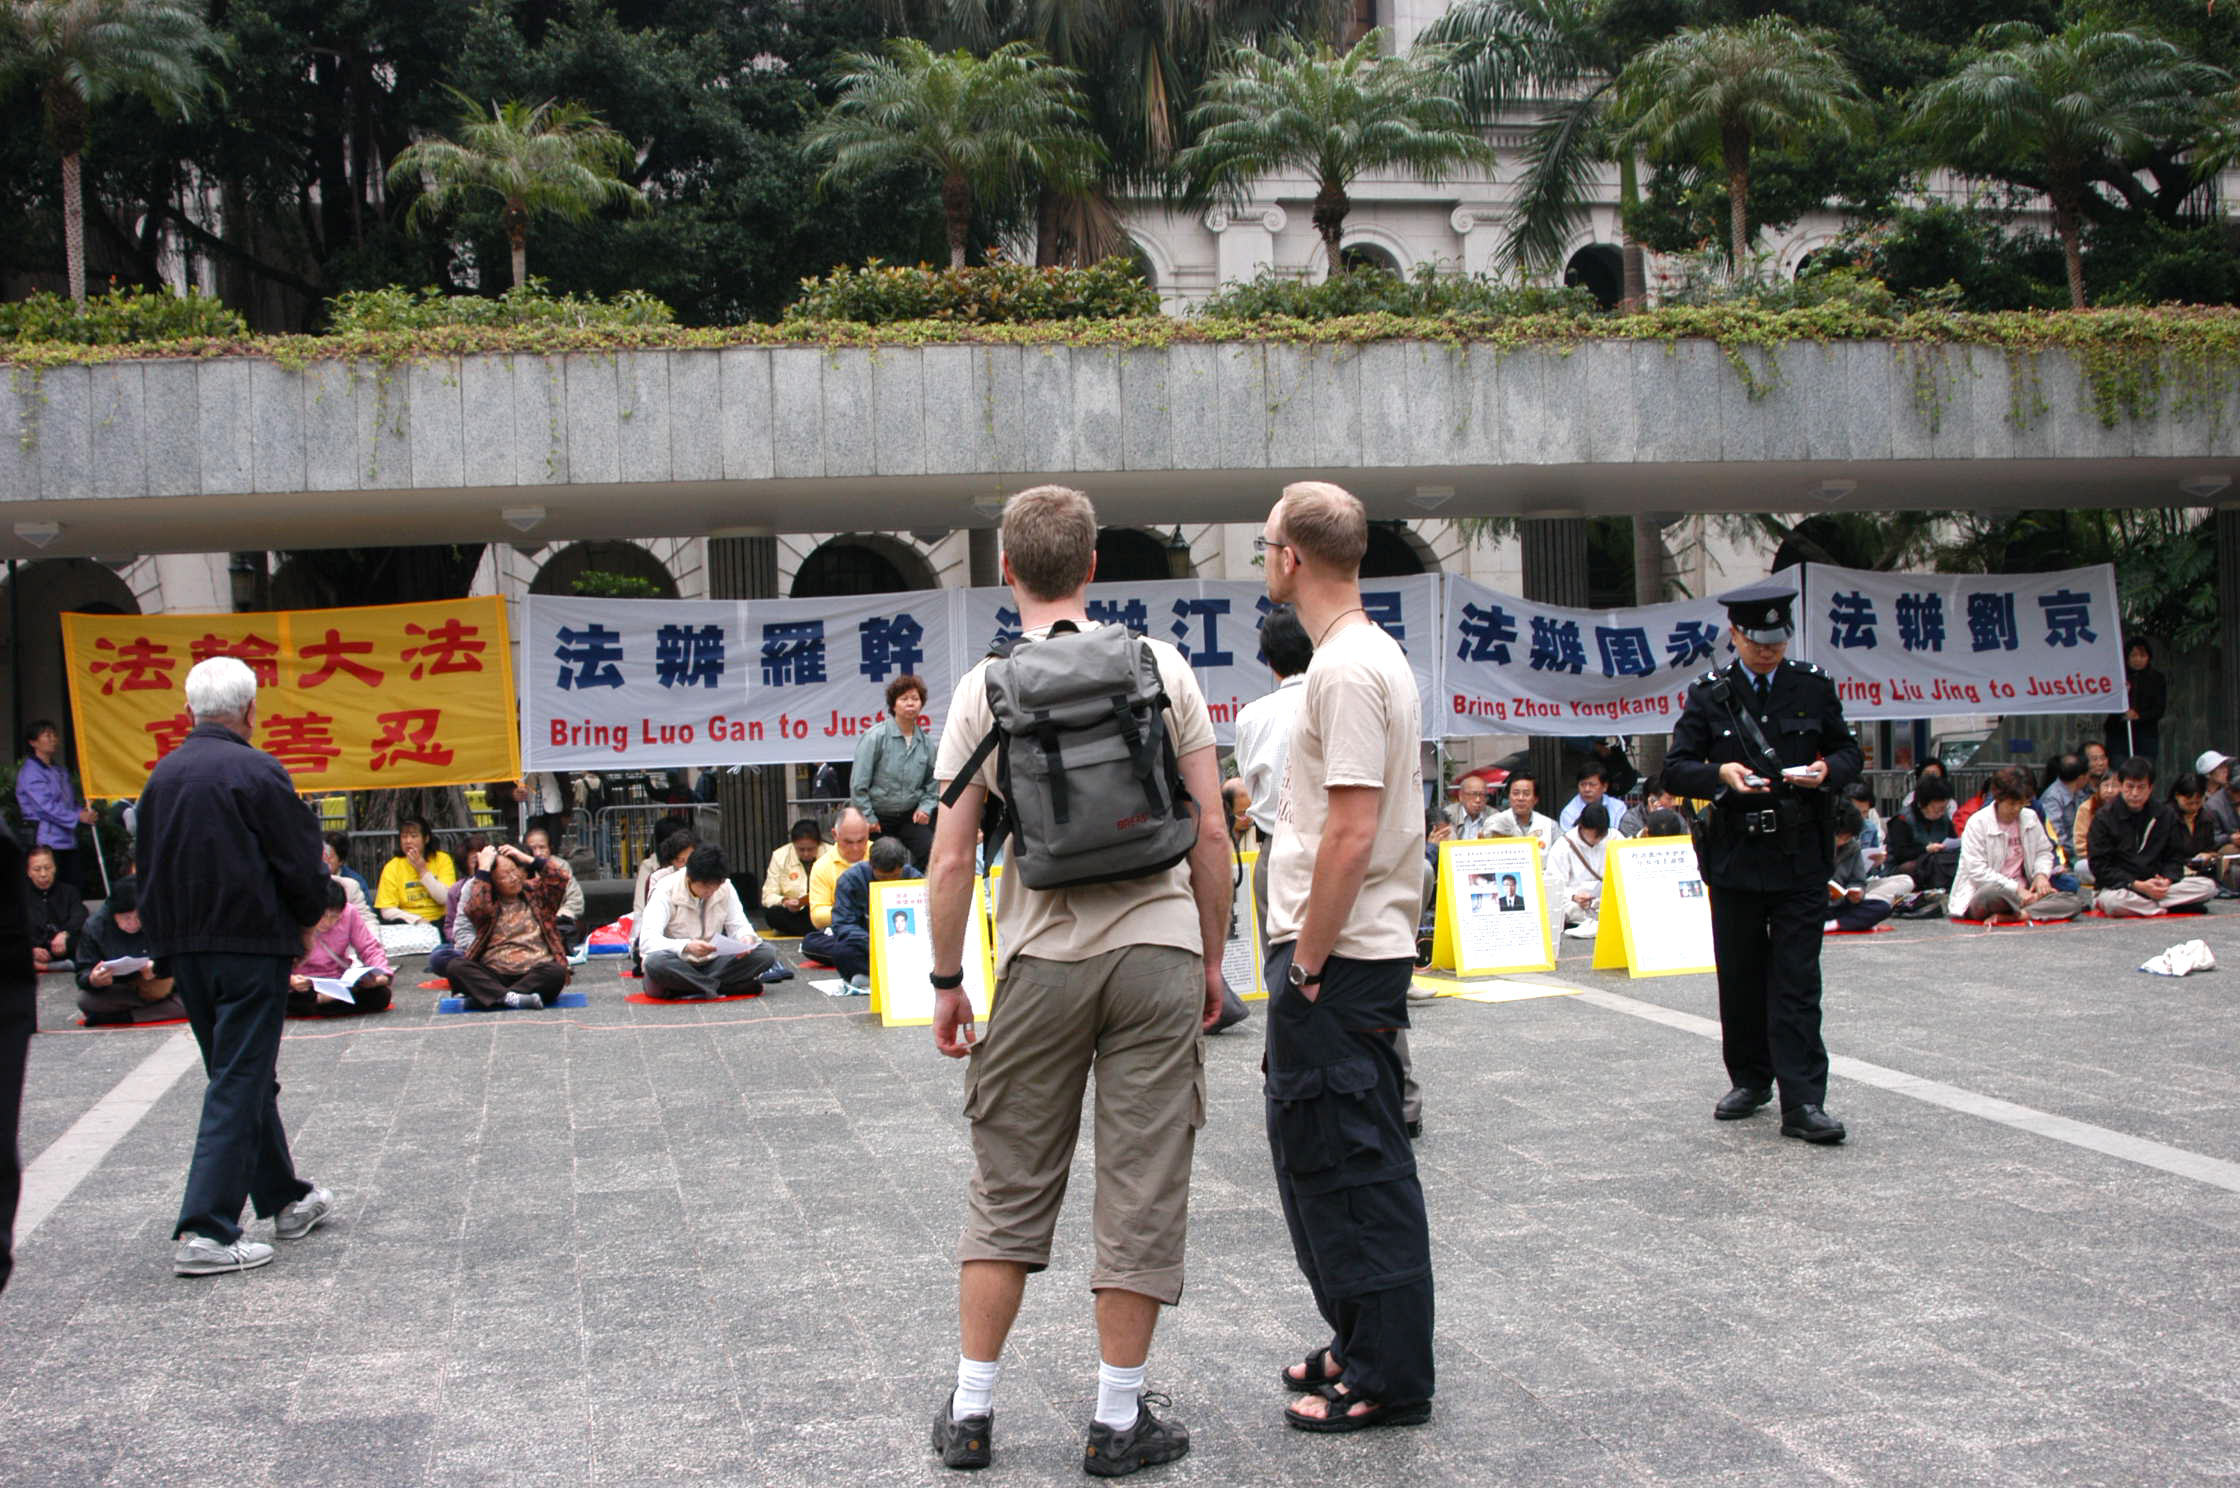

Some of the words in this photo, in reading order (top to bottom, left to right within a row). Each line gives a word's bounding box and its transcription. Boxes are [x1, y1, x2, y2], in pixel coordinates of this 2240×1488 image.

[1456, 602, 1737, 678] 法辦周永
[1829, 588, 2099, 653] 法辦劉京
[554, 613, 924, 691] 法辦羅幹
[1452, 694, 1507, 721] Bring
[1513, 697, 1561, 718] Zhou
[1569, 694, 1670, 721] Yongkang
[1836, 676, 1882, 706] ring
[1890, 678, 1924, 701] Liu
[1930, 677, 1978, 704] Jing
[1988, 679, 2016, 699] to
[2026, 672, 2112, 698] Justice
[550, 718, 628, 753] Bring
[642, 718, 694, 745] Luo
[708, 715, 764, 742] Gan
[780, 713, 808, 740] to
[824, 709, 932, 737] Juste
